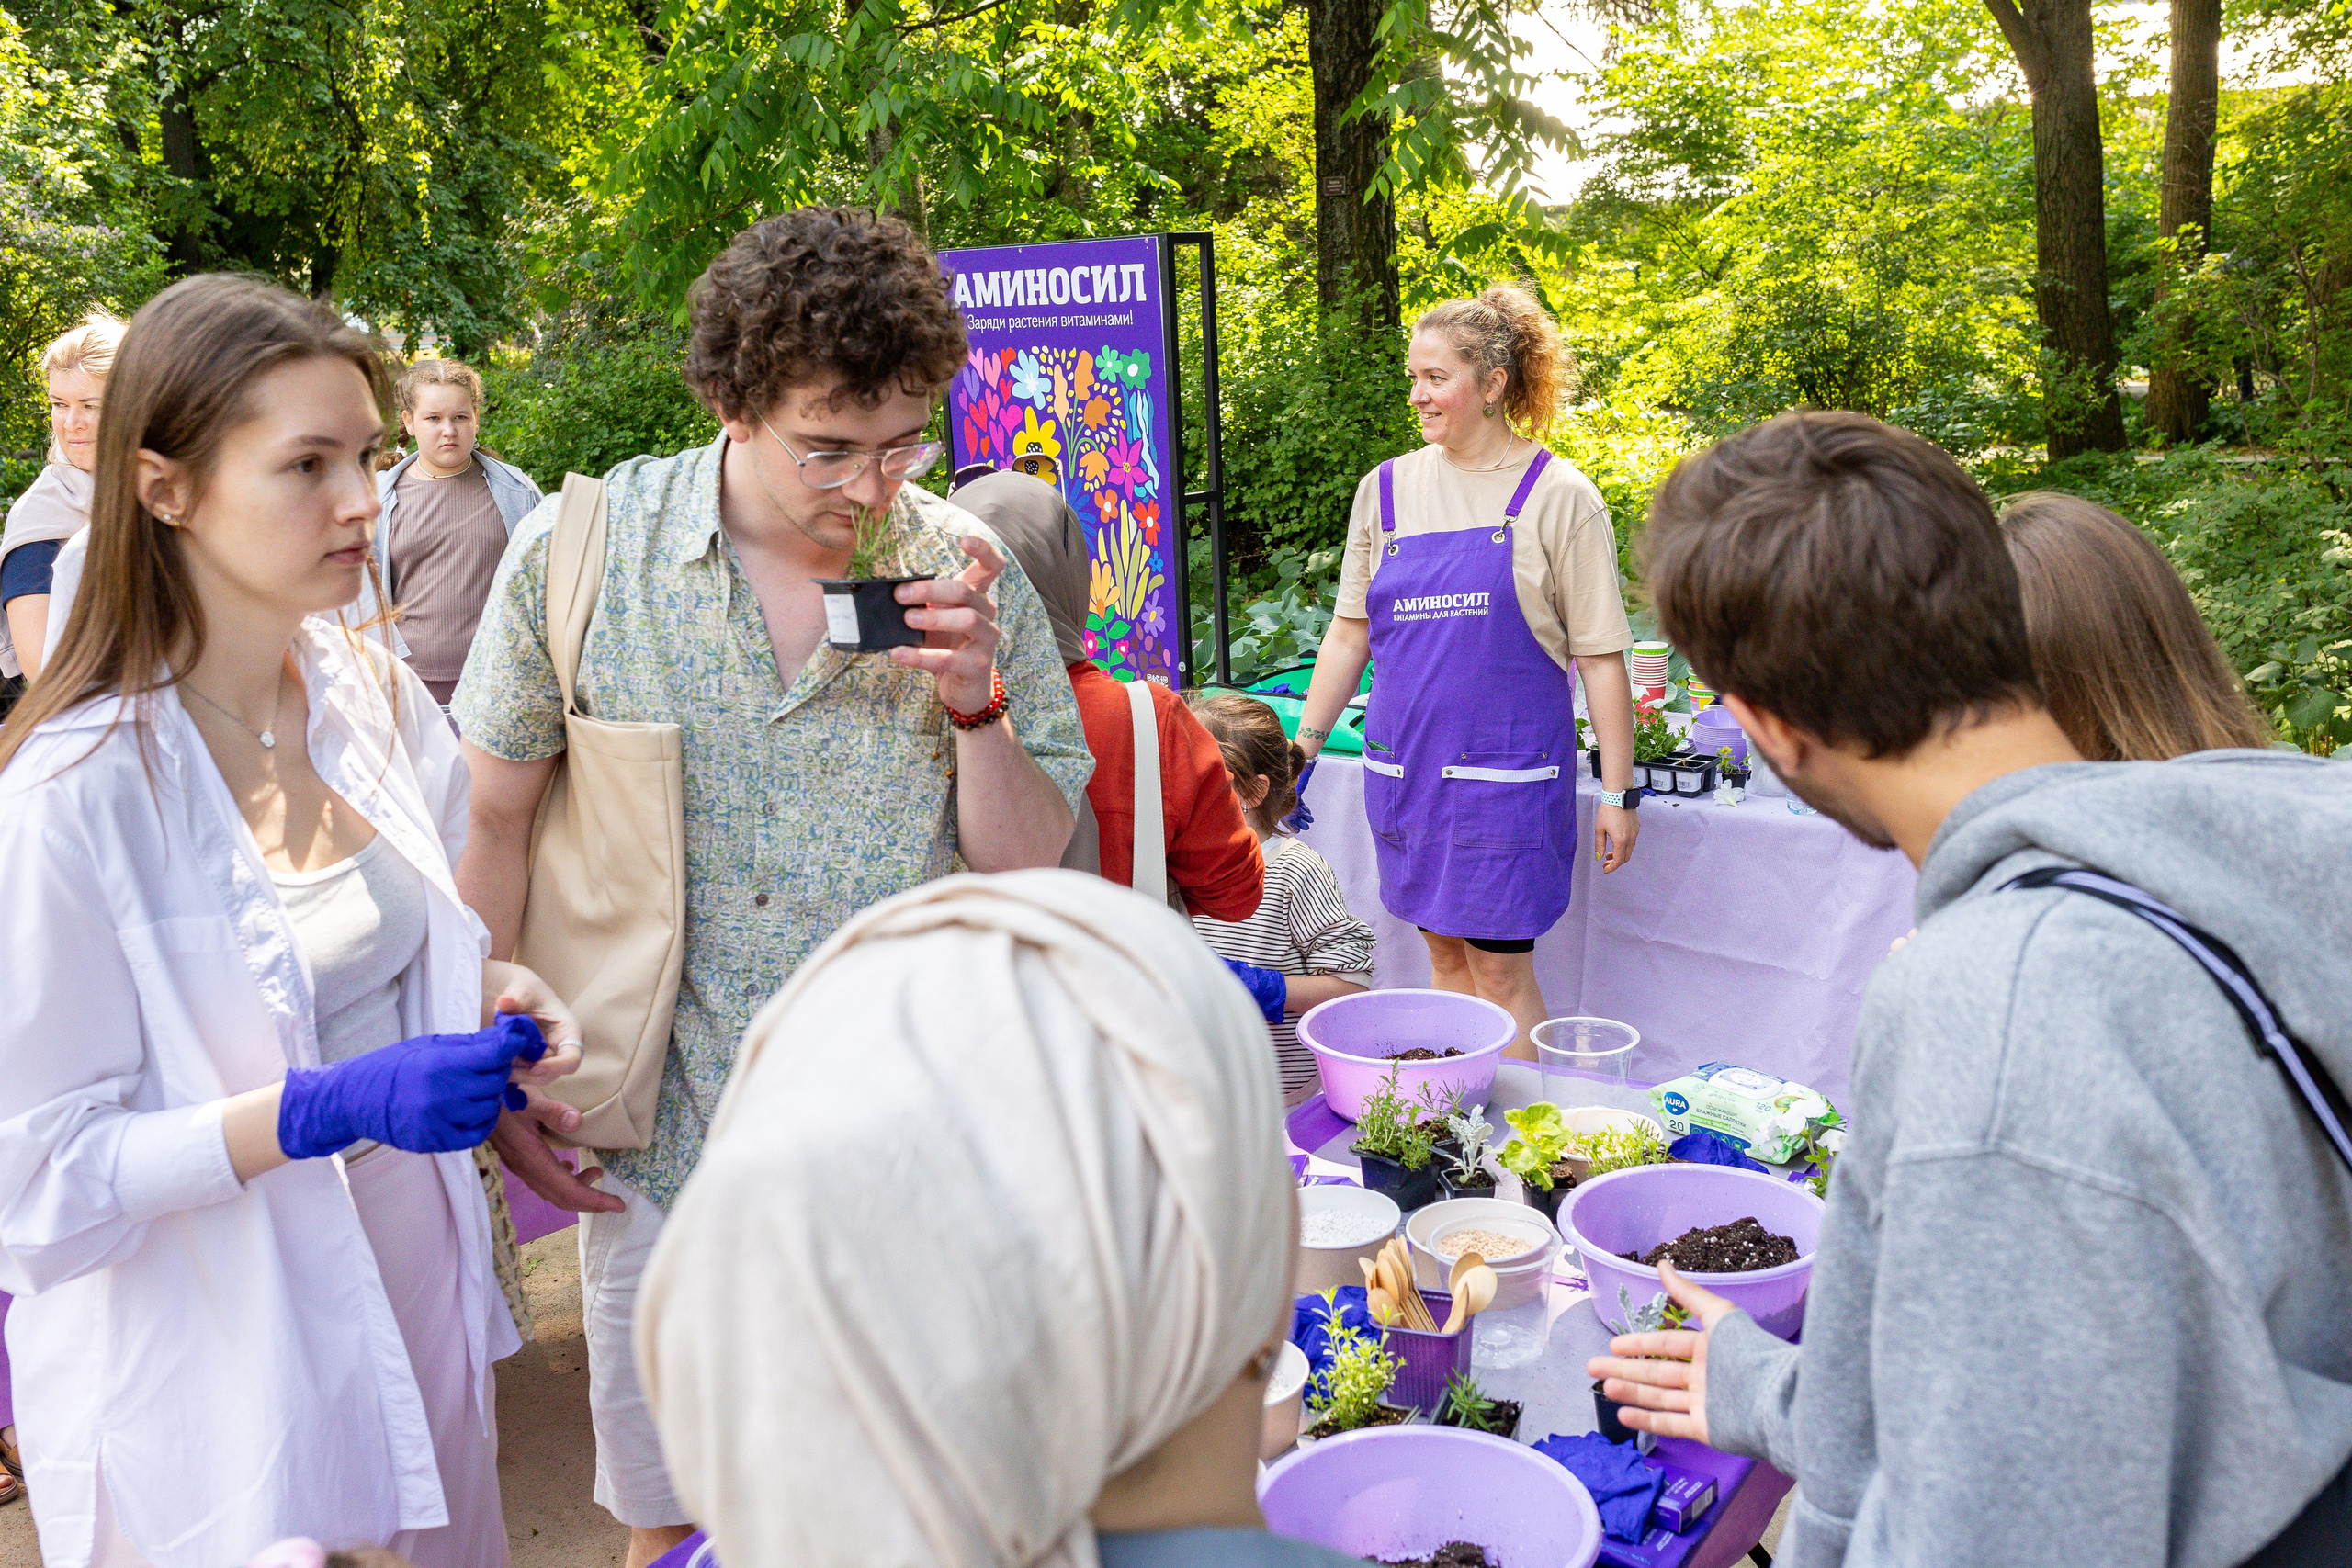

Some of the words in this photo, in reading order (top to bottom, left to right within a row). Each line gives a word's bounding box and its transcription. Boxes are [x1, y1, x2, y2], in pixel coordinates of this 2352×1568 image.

[954, 263, 1147, 309] АМИНОСИЛ
[967, 313, 1006, 334] Заряди
[1009, 315, 1058, 333] растения
[1060, 309, 1134, 328] витаминами!
[1393, 592, 1490, 612] АМИНОСИЛ
[1393, 612, 1431, 621] ВИТАМИНЫ
[1432, 610, 1449, 619] ДЛЯ
[1450, 607, 1489, 616] РАСТЕНИЙ
[1665, 1096, 1686, 1109] AURA
